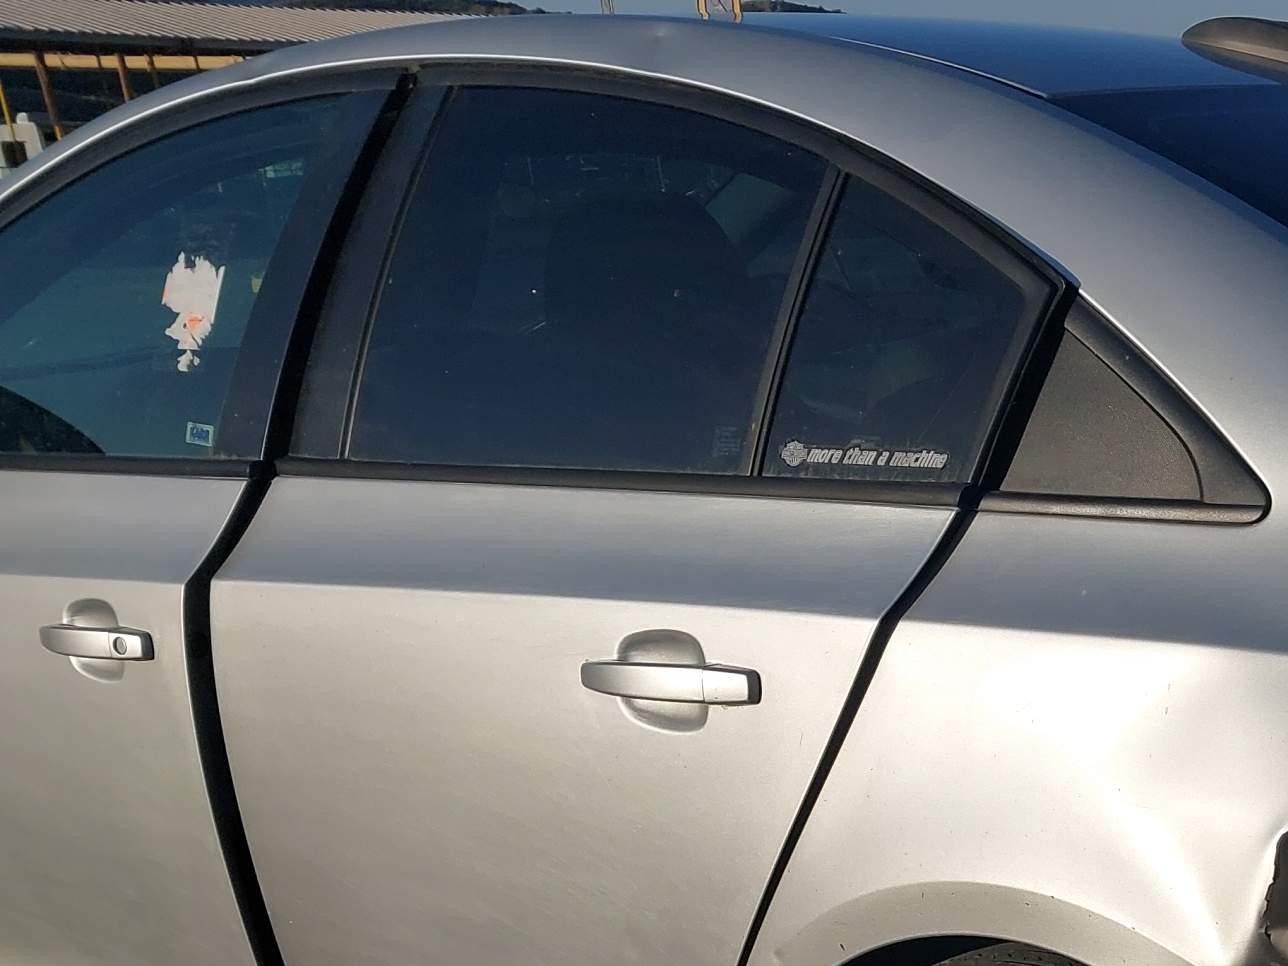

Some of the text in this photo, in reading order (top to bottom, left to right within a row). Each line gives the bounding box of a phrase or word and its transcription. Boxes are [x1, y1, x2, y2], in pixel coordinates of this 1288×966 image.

[807, 447, 843, 463] more
[843, 447, 877, 466] than
[877, 450, 889, 465] a
[890, 450, 948, 468] machine
